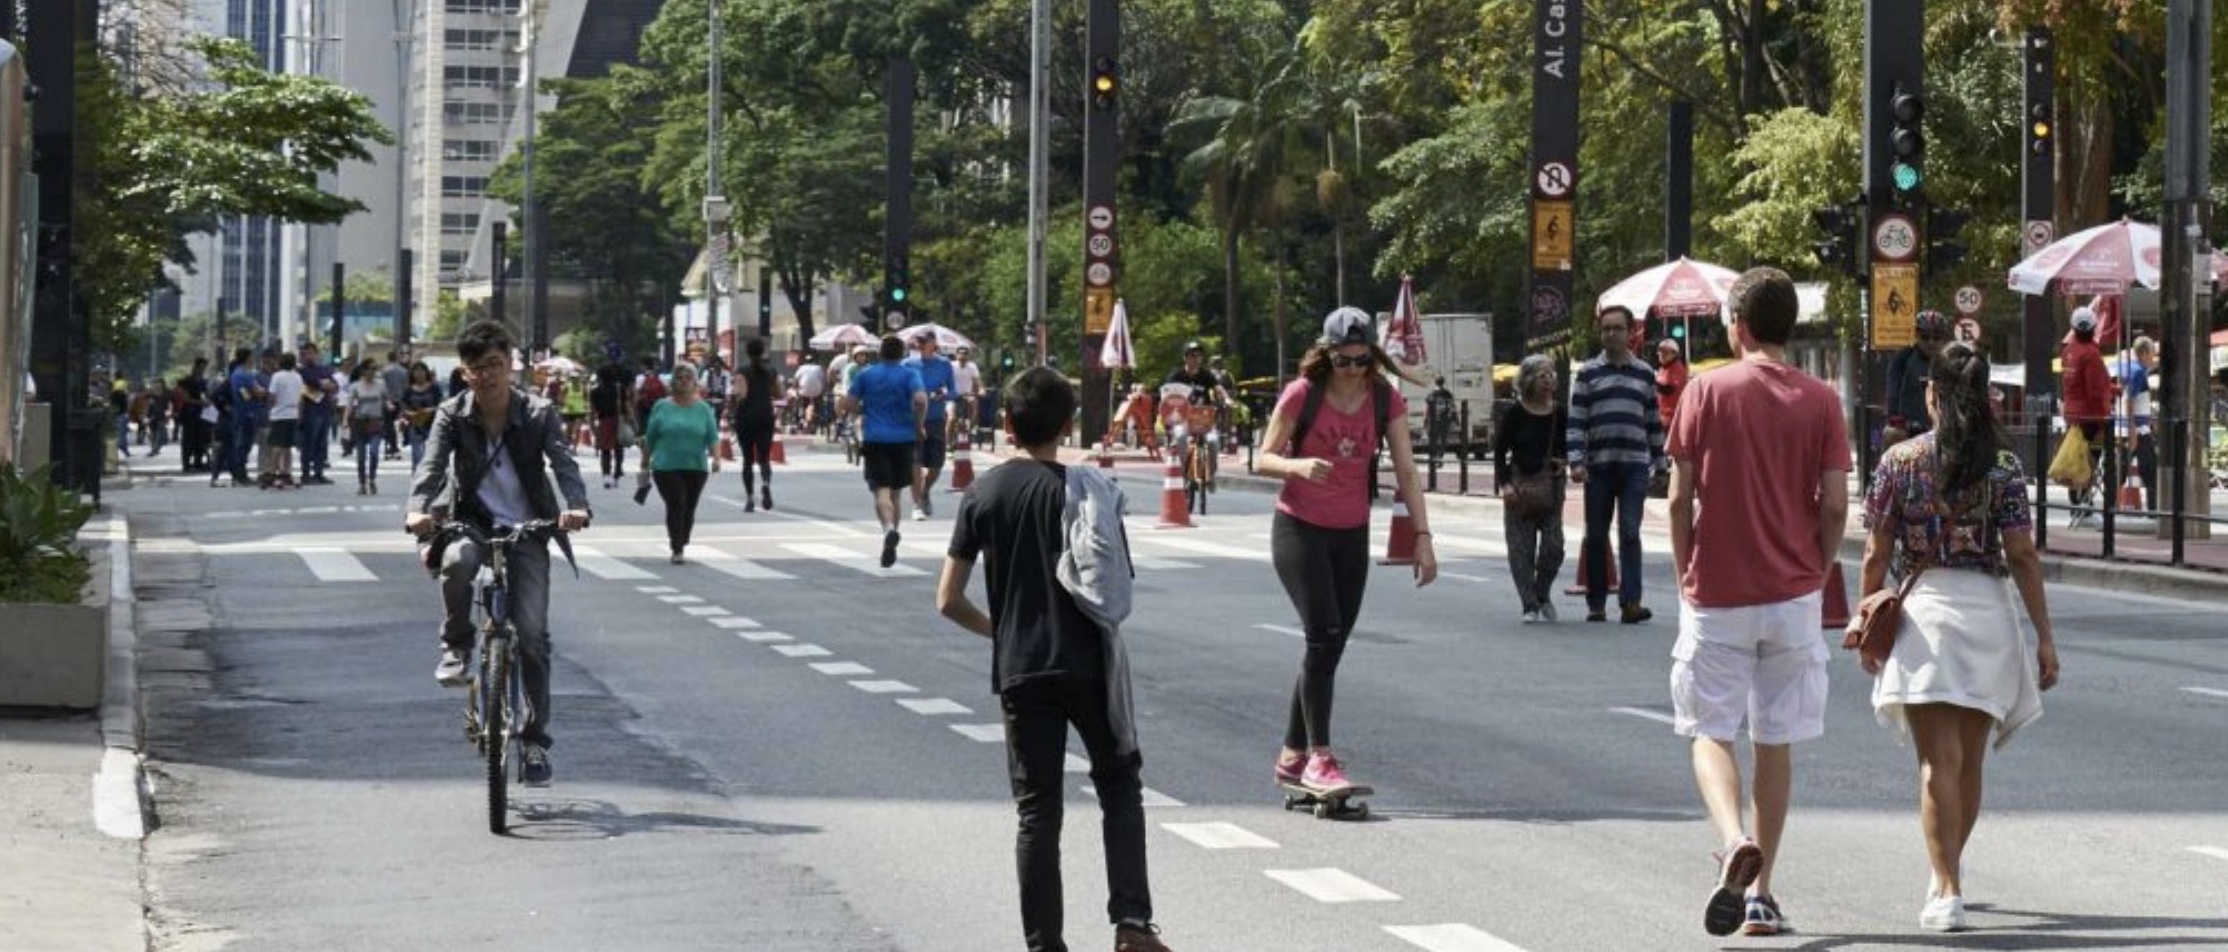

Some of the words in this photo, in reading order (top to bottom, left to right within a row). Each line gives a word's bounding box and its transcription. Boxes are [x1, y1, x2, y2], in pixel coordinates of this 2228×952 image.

[1545, 0, 1565, 36] Ca
[1543, 45, 1564, 78] Al.
[1093, 238, 1108, 250] 50
[1959, 291, 1978, 305] 50
